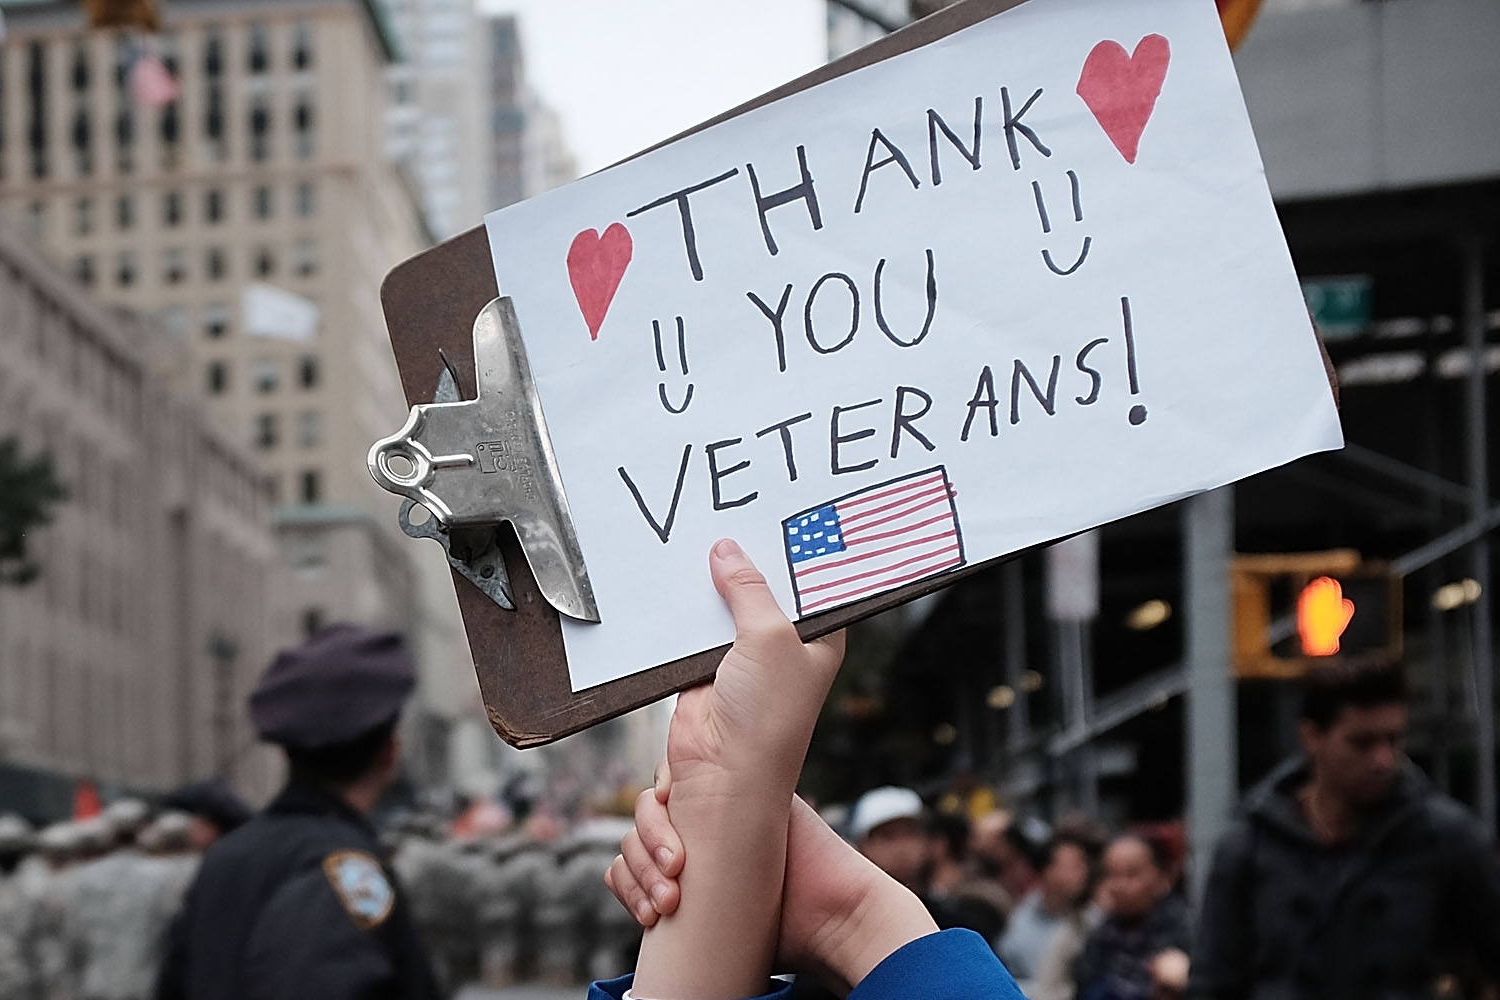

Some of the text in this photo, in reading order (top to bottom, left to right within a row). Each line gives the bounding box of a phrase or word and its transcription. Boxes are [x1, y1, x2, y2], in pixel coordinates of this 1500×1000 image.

[627, 87, 1051, 281] THANK
[747, 249, 936, 372] YOU
[618, 297, 1147, 544] VETERANS!
